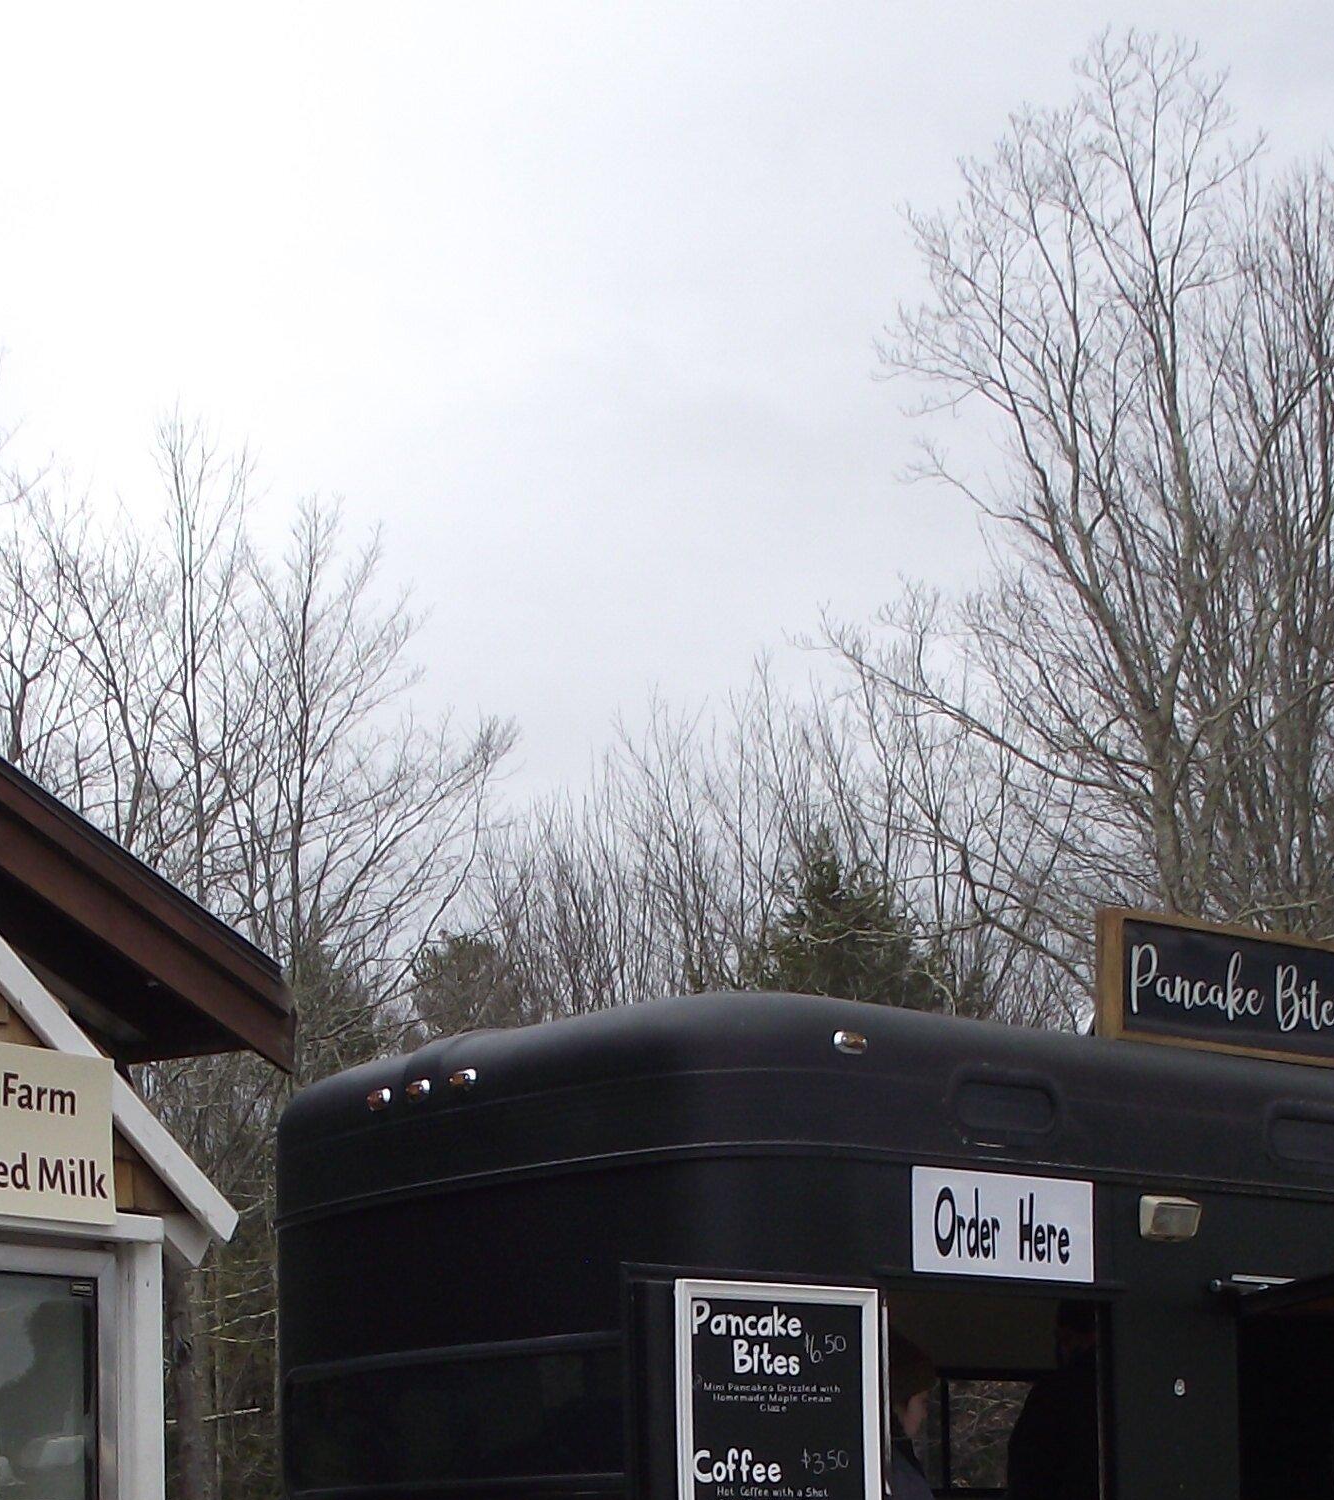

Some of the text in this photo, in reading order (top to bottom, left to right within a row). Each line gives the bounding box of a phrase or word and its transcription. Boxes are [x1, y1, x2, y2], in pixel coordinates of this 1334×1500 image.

[1130, 942, 1265, 1021] Pancake
[1, 1071, 77, 1117] Farm
[38, 1156, 109, 1200] Milk
[934, 1186, 1071, 1264] Order Here
[692, 1300, 802, 1338] Pancake
[733, 1338, 800, 1376] Bites
[713, 1393, 833, 1404] Homemade Maple Cream
[728, 1383, 774, 1393] Pancakes
[777, 1384, 817, 1393] Drizzled
[819, 1385, 841, 1394] with
[693, 1448, 782, 1483] Coffee
[717, 1486, 828, 1498] Hot Coffee with a Shot
